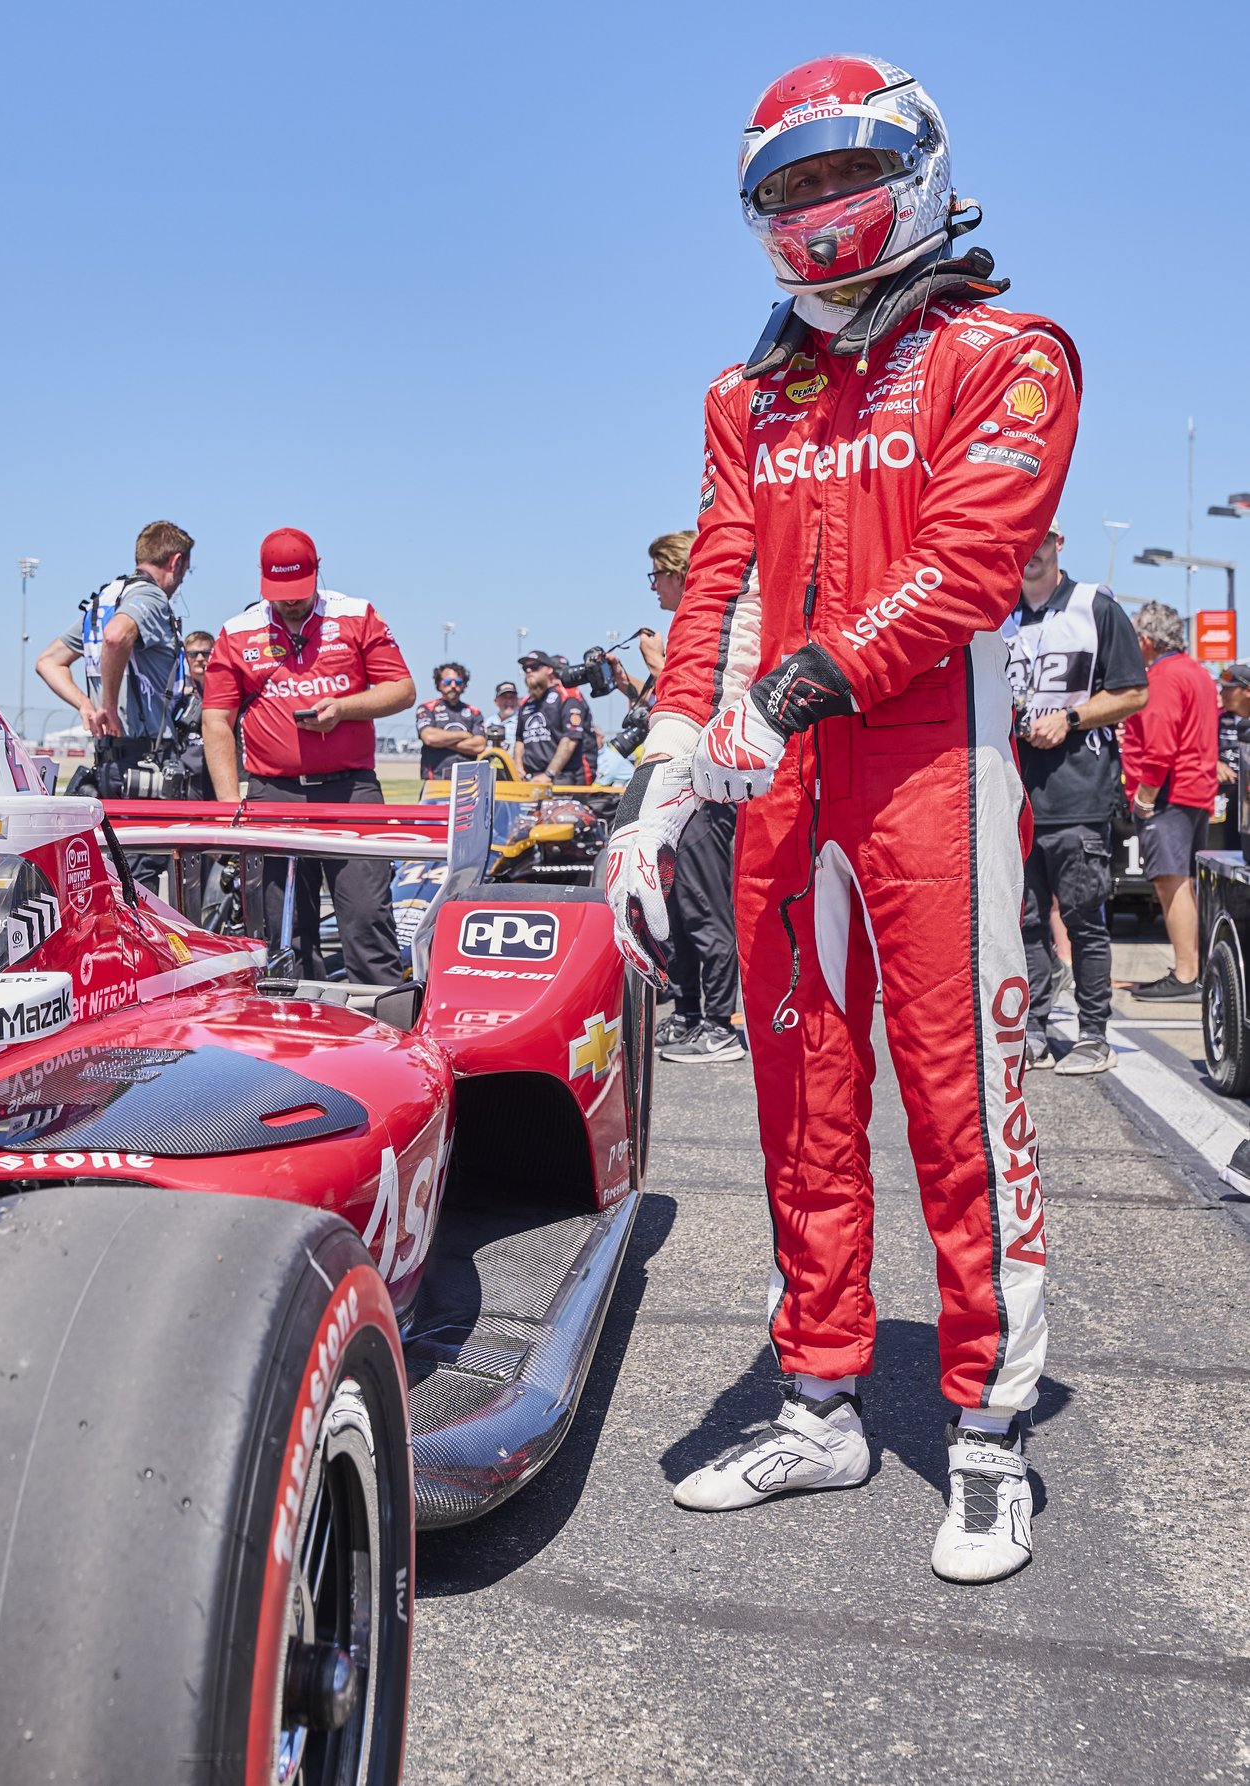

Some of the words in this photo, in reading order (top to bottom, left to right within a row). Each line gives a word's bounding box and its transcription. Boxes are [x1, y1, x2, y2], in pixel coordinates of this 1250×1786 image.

[778, 104, 843, 133] Astemo
[899, 208, 914, 219] BELL
[959, 329, 991, 347] OMP
[866, 379, 924, 402] verizon
[883, 398, 919, 413] RACK
[1002, 427, 1047, 448] Gallagher
[754, 430, 915, 492] Astemo
[988, 447, 1039, 467] CHAMPION
[271, 563, 300, 573] Astemo
[842, 567, 943, 651] Astemo
[317, 643, 348, 653] verizon
[264, 673, 350, 698] Astemo
[67, 869, 91, 884] INDYCAR
[465, 915, 553, 955] PPG
[443, 965, 555, 981] Snap-on
[272, 1285, 360, 1566] Firestone
